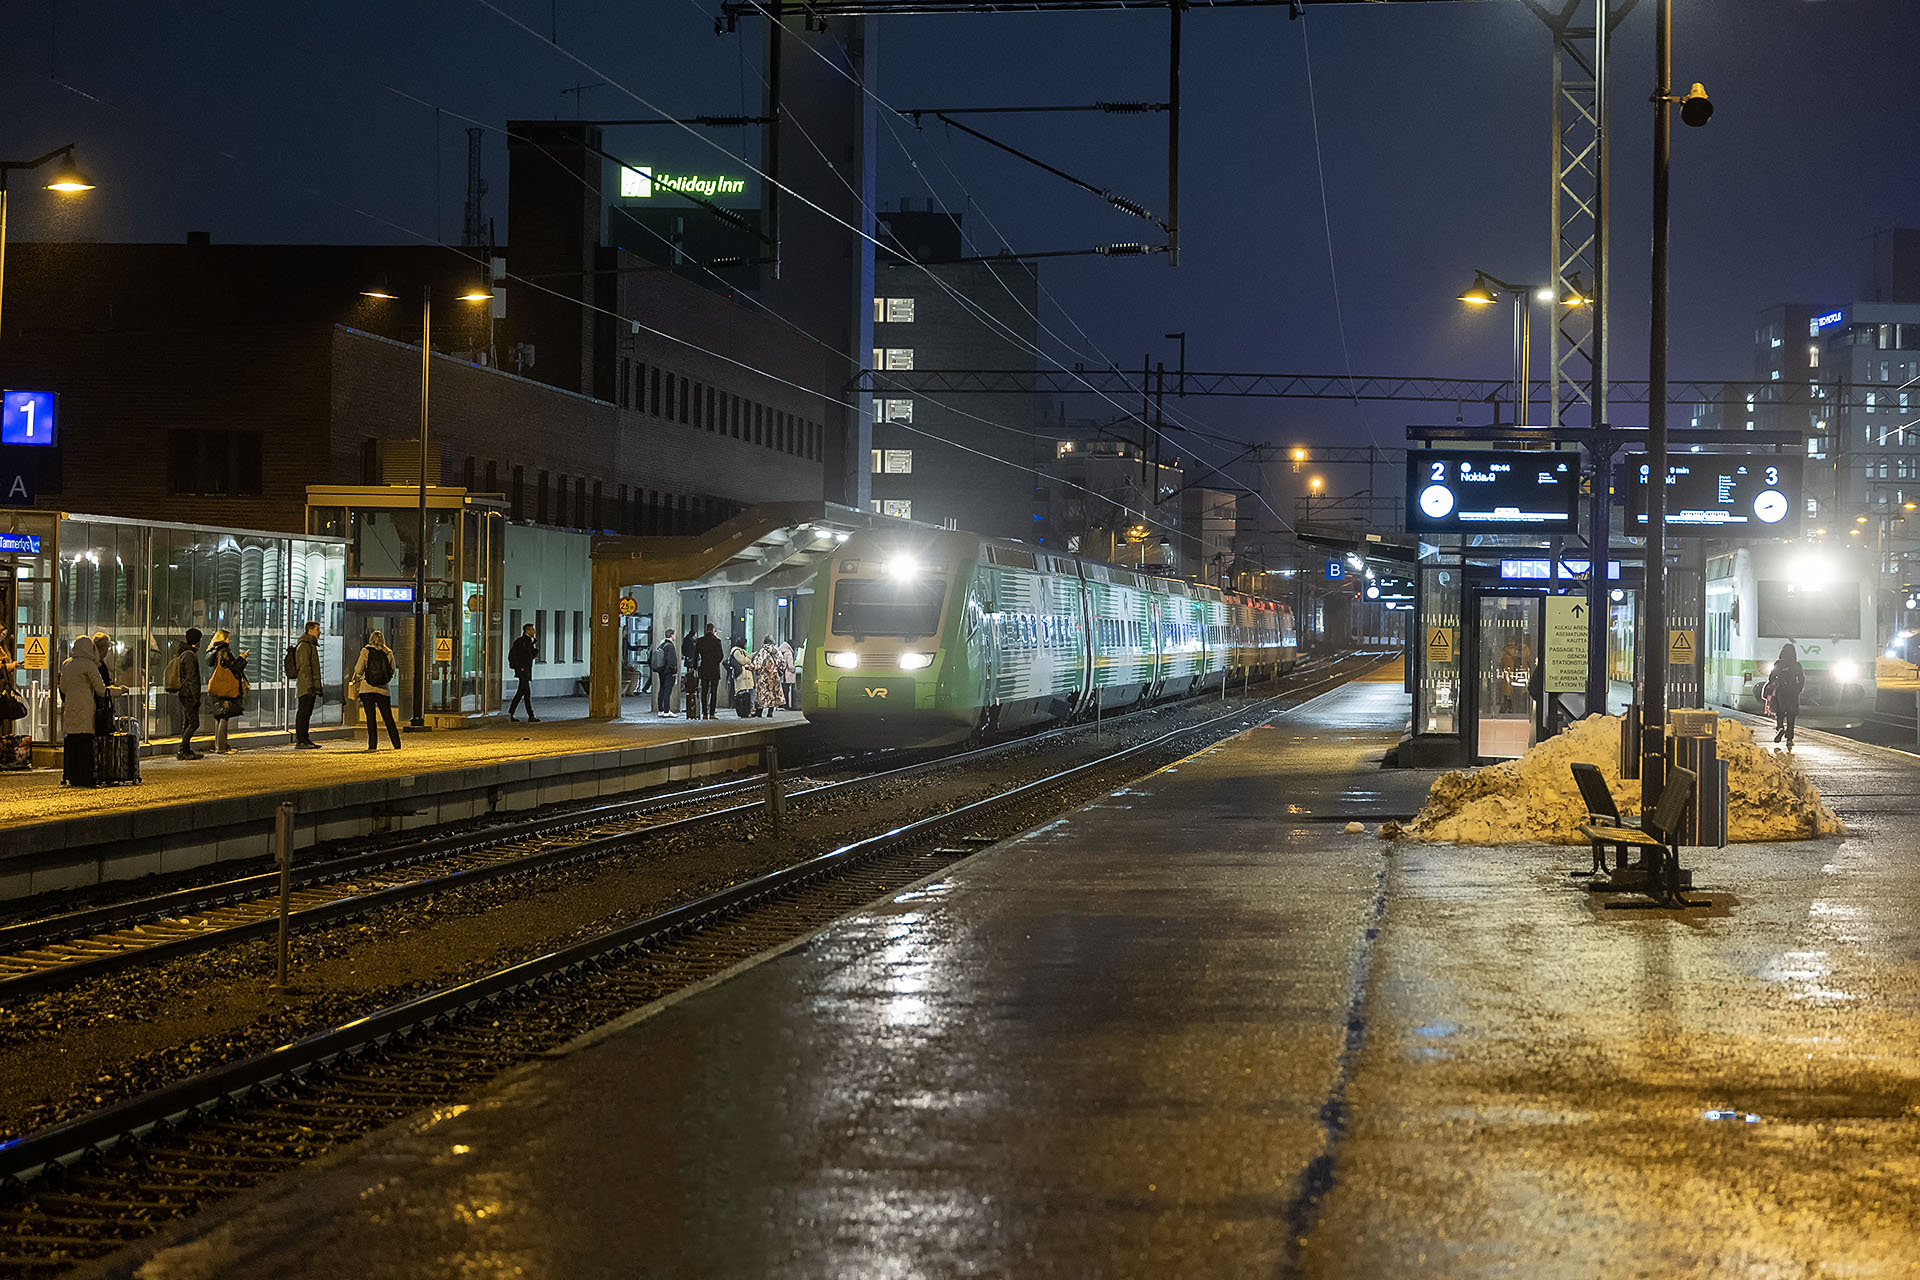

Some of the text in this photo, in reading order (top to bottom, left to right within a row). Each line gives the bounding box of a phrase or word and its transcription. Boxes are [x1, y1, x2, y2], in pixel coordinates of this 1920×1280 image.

[654, 174, 745, 196] Holiday Inn
[20, 400, 35, 437] 1
[1430, 462, 1445, 481] 2
[1676, 466, 1690, 475] min
[1765, 466, 1779, 486] 3
[8, 475, 28, 498] A
[1330, 563, 1341, 577] B
[1800, 645, 1822, 655] VR
[864, 687, 888, 699] VR
